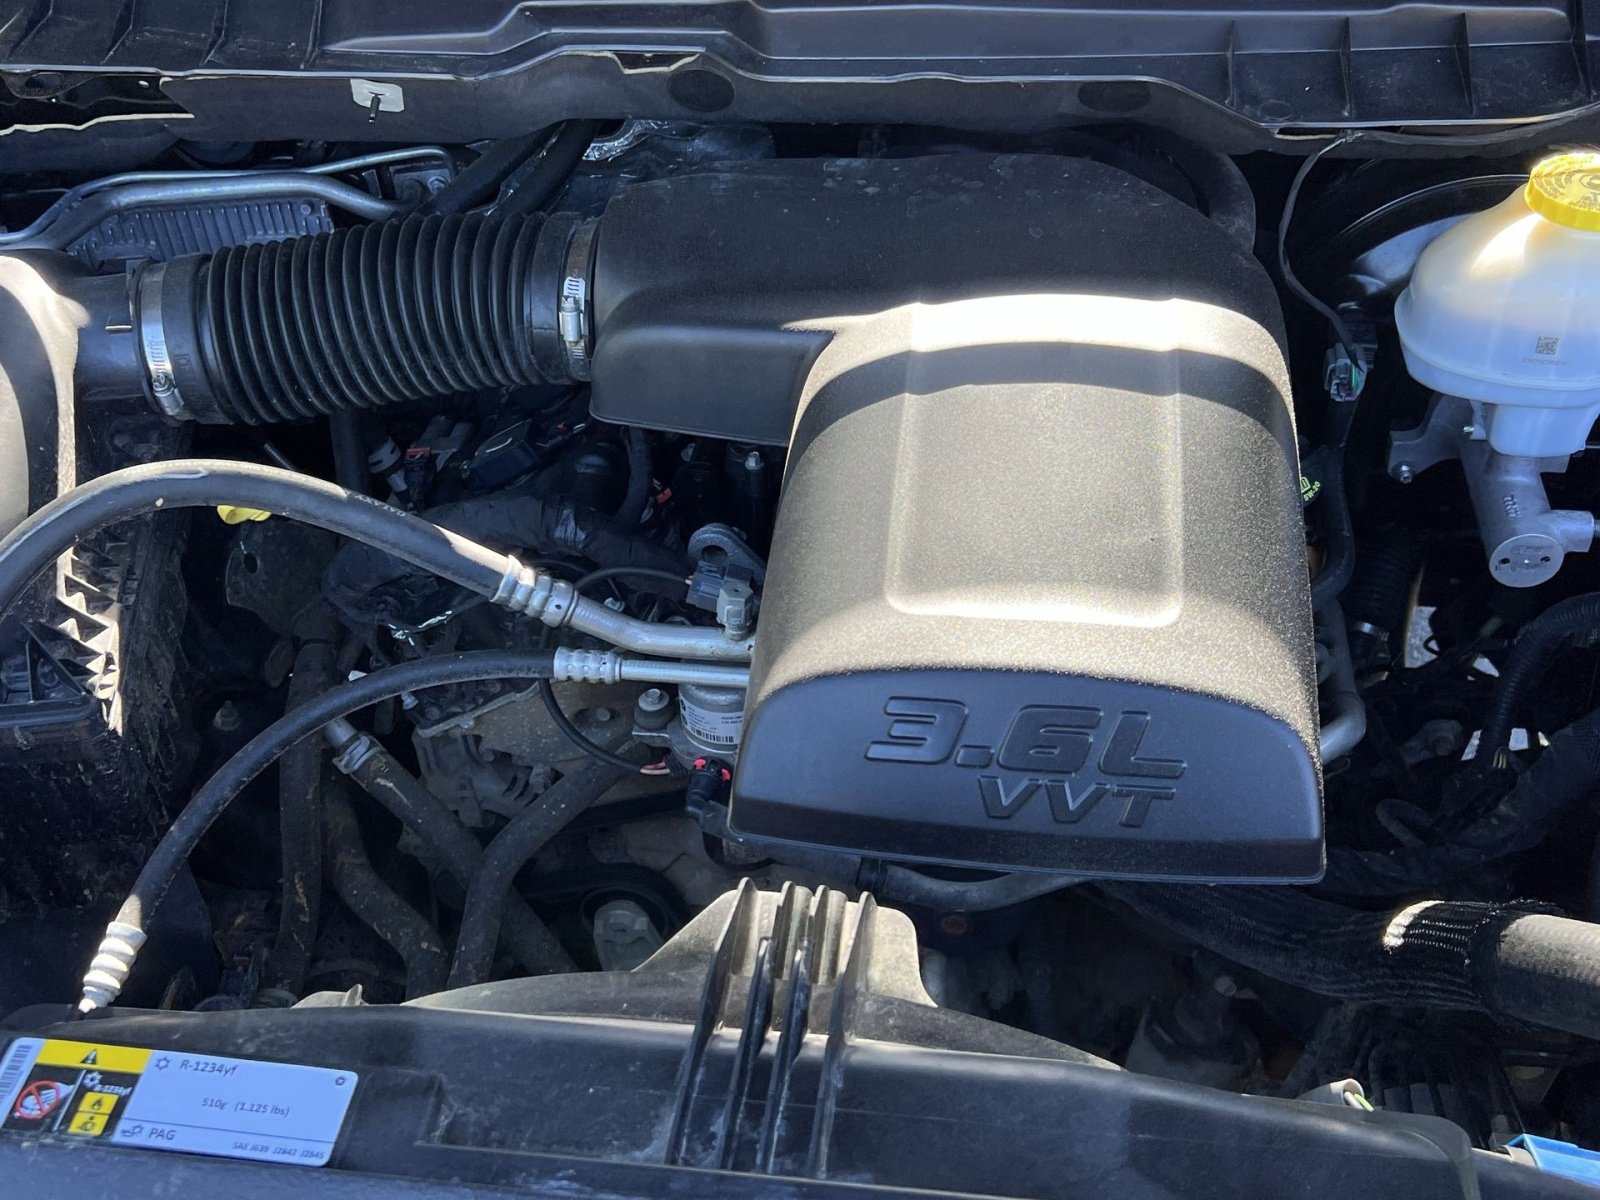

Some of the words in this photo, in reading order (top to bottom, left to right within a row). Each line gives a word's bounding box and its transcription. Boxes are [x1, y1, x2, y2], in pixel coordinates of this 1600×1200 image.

[864, 696, 1188, 779] 3.6L
[977, 774, 1177, 828] VVT
[180, 1059, 238, 1077] R-1234yf
[201, 1098, 229, 1110] 510g
[234, 1101, 268, 1113] (1.125
[269, 1104, 290, 1118] lbs)
[149, 1128, 176, 1140] PAG
[232, 1141, 249, 1151] SAE
